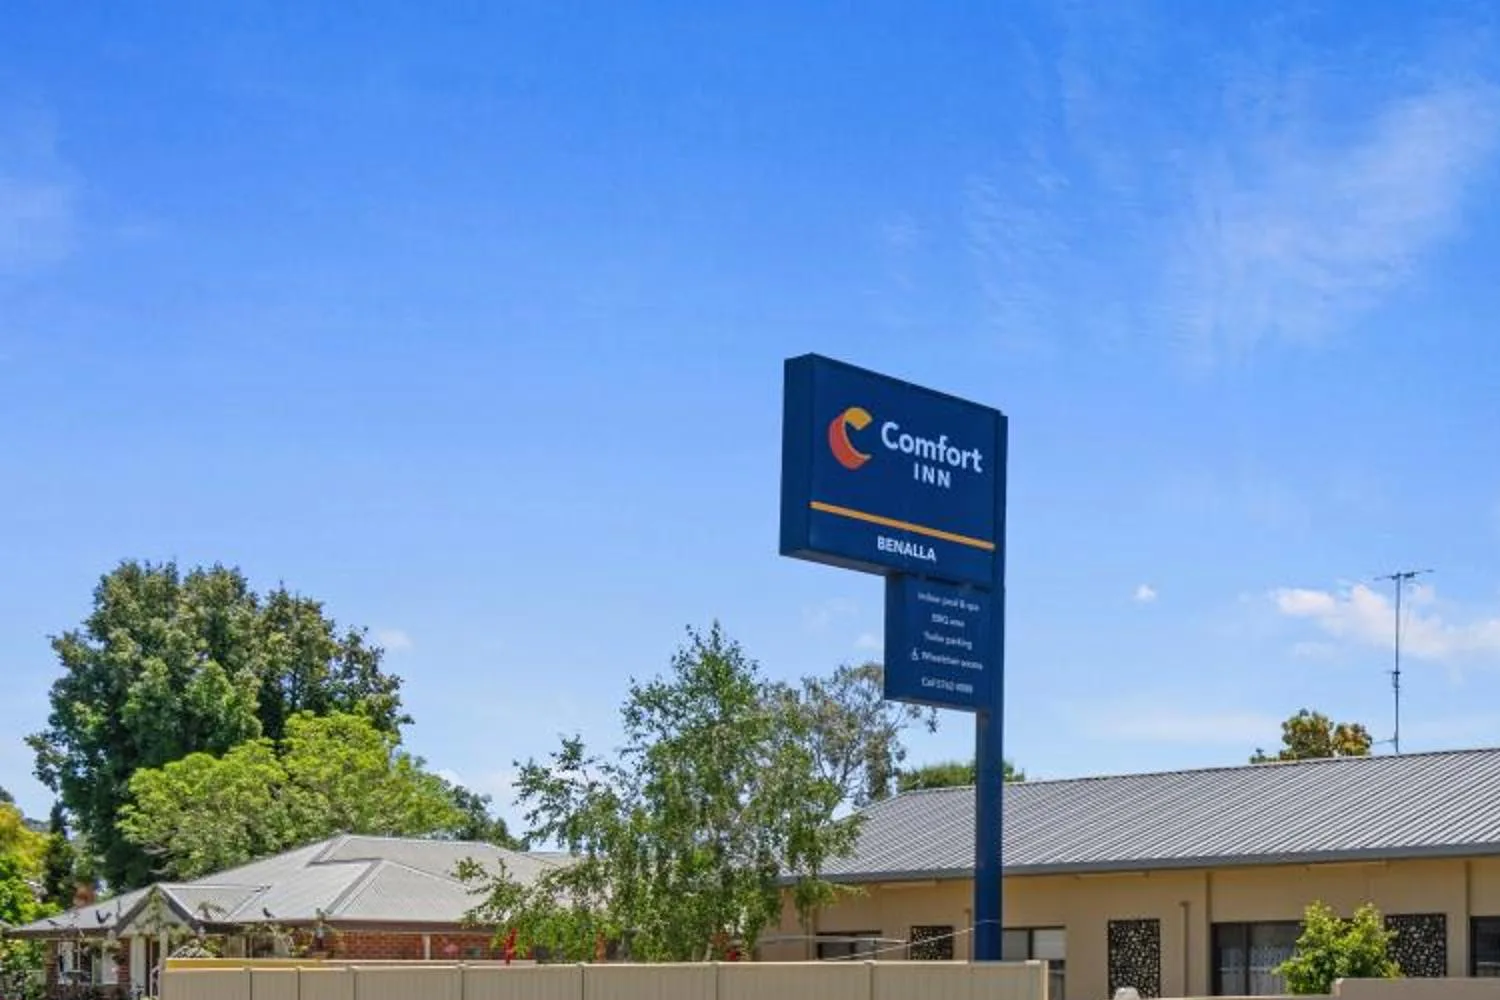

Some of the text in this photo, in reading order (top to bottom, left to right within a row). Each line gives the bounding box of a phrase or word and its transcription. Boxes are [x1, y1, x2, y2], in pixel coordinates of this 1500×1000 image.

[881, 421, 983, 473] Comfort
[913, 463, 951, 488] INN
[877, 535, 936, 562] BENALLA
